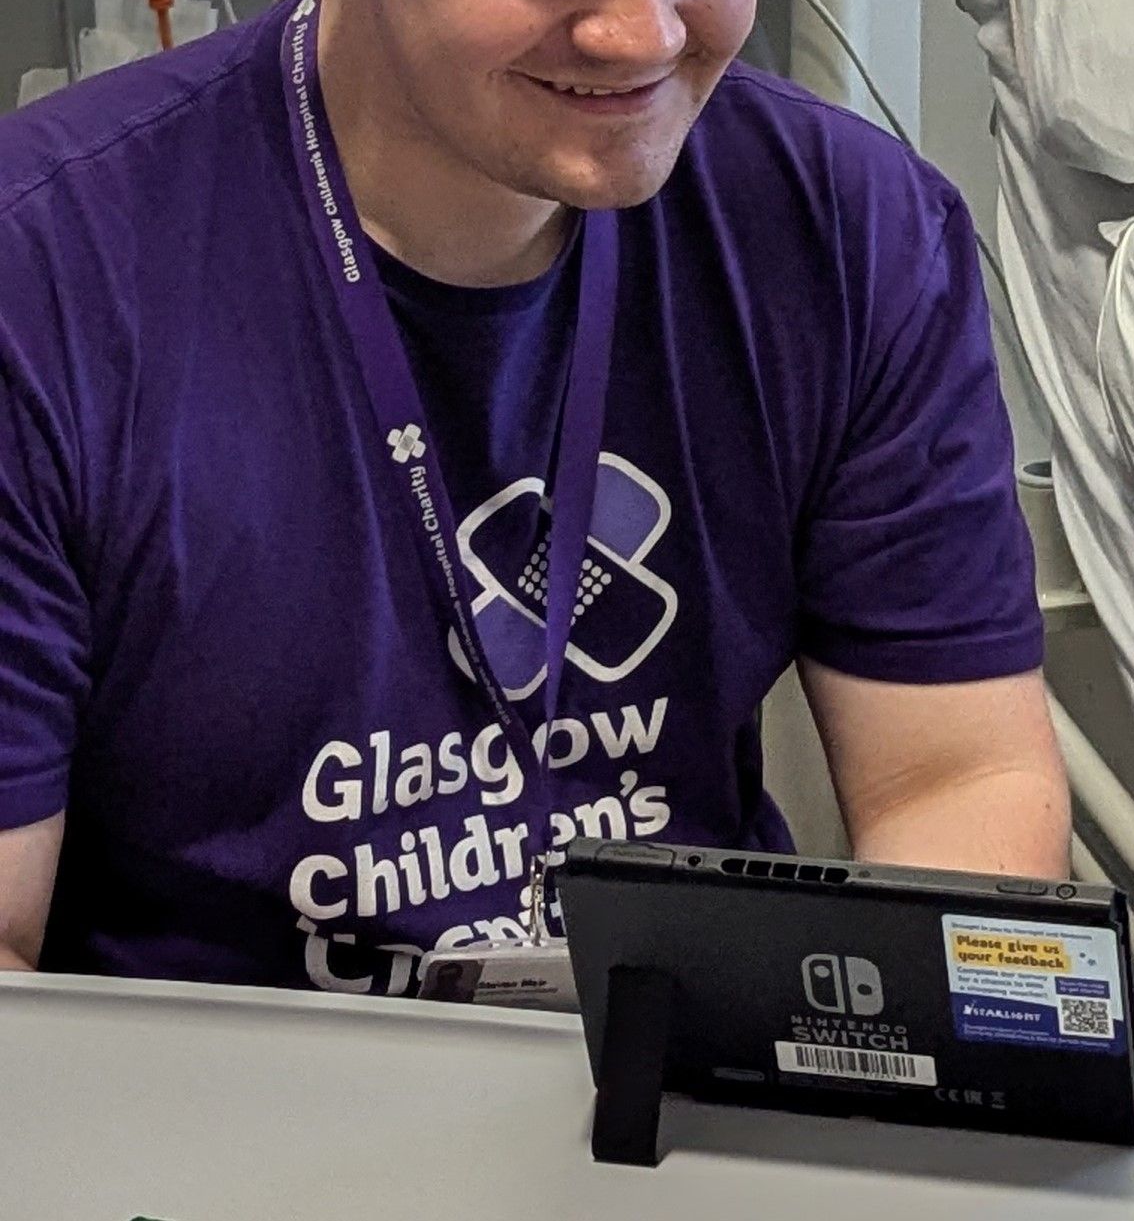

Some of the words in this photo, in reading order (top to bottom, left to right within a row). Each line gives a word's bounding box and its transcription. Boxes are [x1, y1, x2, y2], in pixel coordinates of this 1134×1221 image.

[291, 21, 308, 85] Charity
[296, 88, 319, 151] Hospital
[310, 151, 338, 217] Children's
[331, 218, 361, 283] Glasgow
[410, 465, 439, 532] Charity
[430, 532, 457, 598] Hospital
[302, 697, 669, 823] Glasgow
[289, 771, 671, 920] Children's
[956, 935, 1002, 950] Please
[1008, 939, 1038, 953] give
[1043, 945, 1060, 954] us
[958, 950, 992, 962] your
[998, 952, 1065, 969] feedback
[790, 1014, 908, 1035] NINTENDO
[792, 1026, 909, 1051] SWITCH
[973, 1008, 1041, 1021] STARLIGHT
